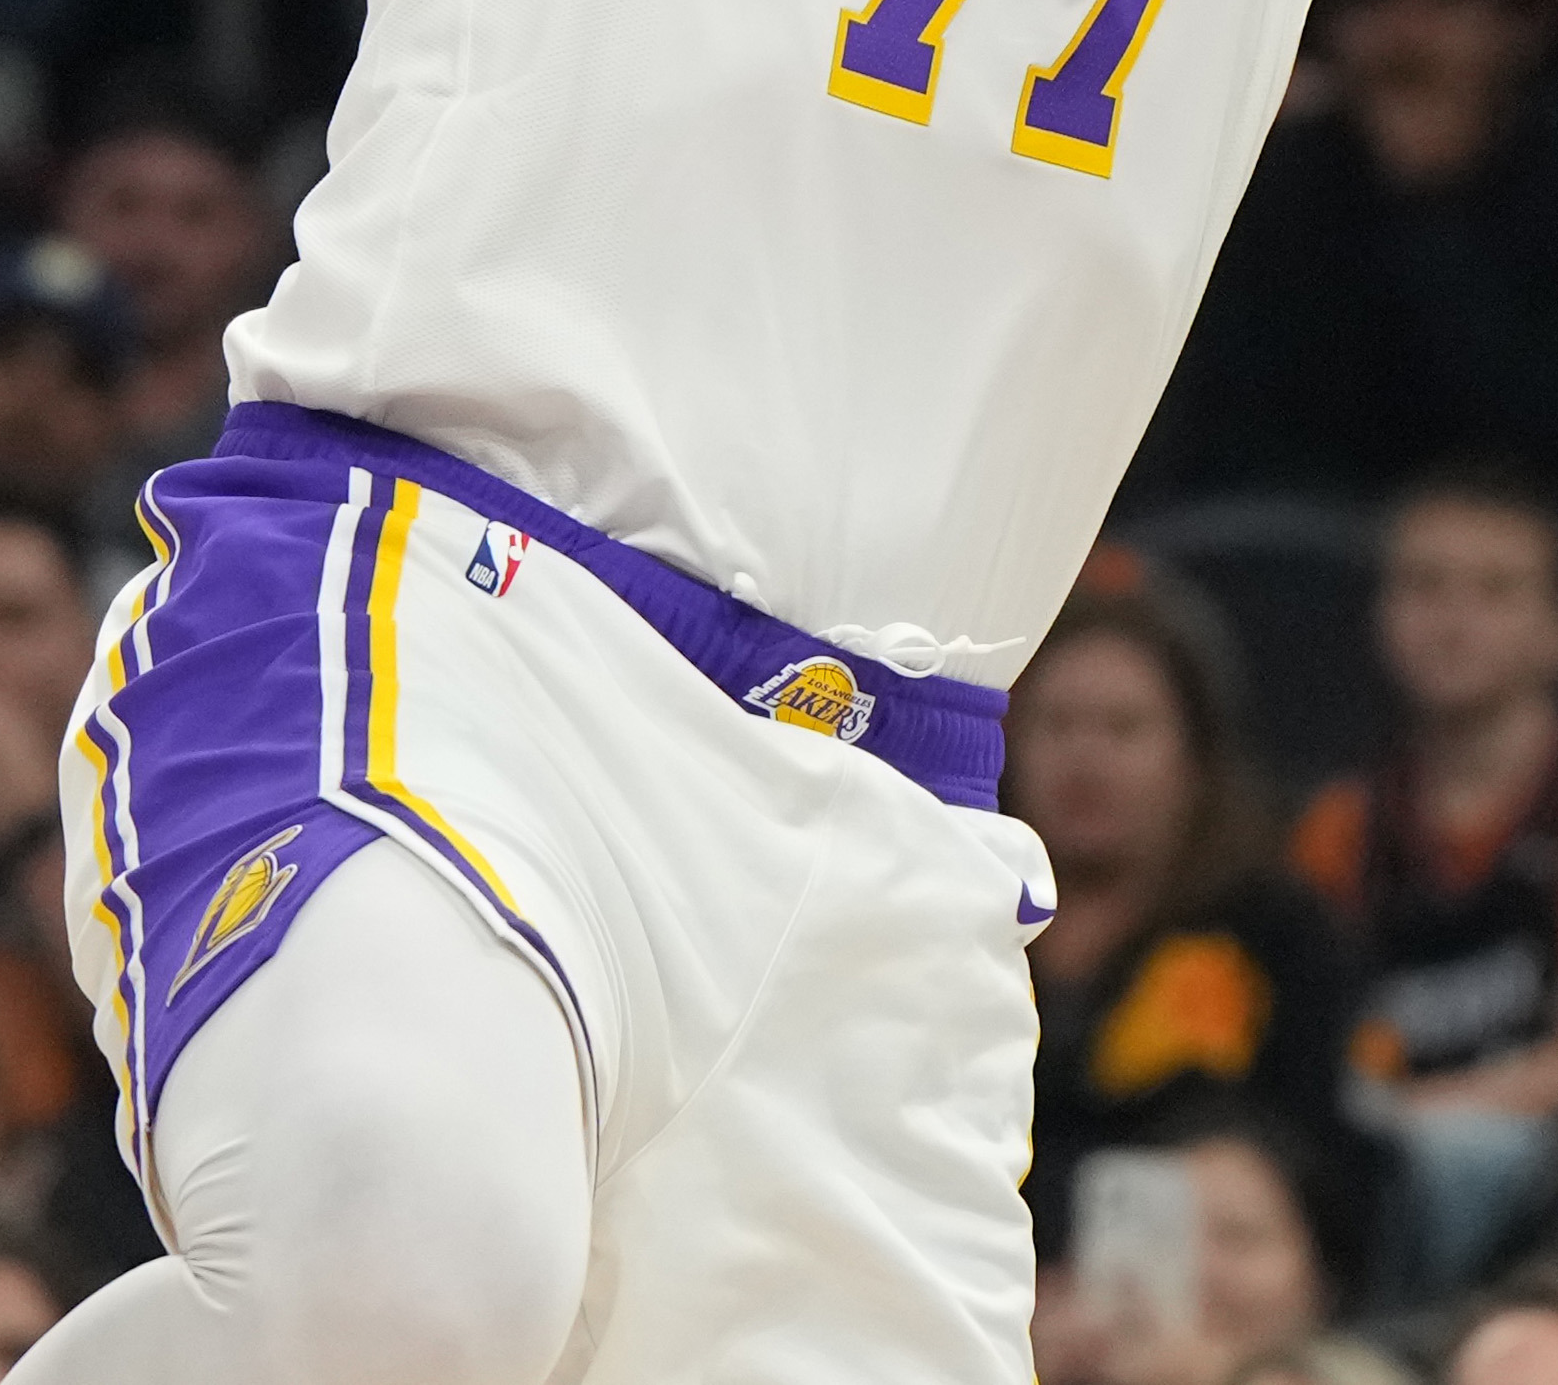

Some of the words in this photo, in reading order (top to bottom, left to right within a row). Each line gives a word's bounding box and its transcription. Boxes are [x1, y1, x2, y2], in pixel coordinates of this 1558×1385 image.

[468, 562, 496, 589] NBA
[752, 671, 867, 741] LAKERS
[807, 678, 830, 692] LOS
[830, 688, 873, 709] ANGELES
